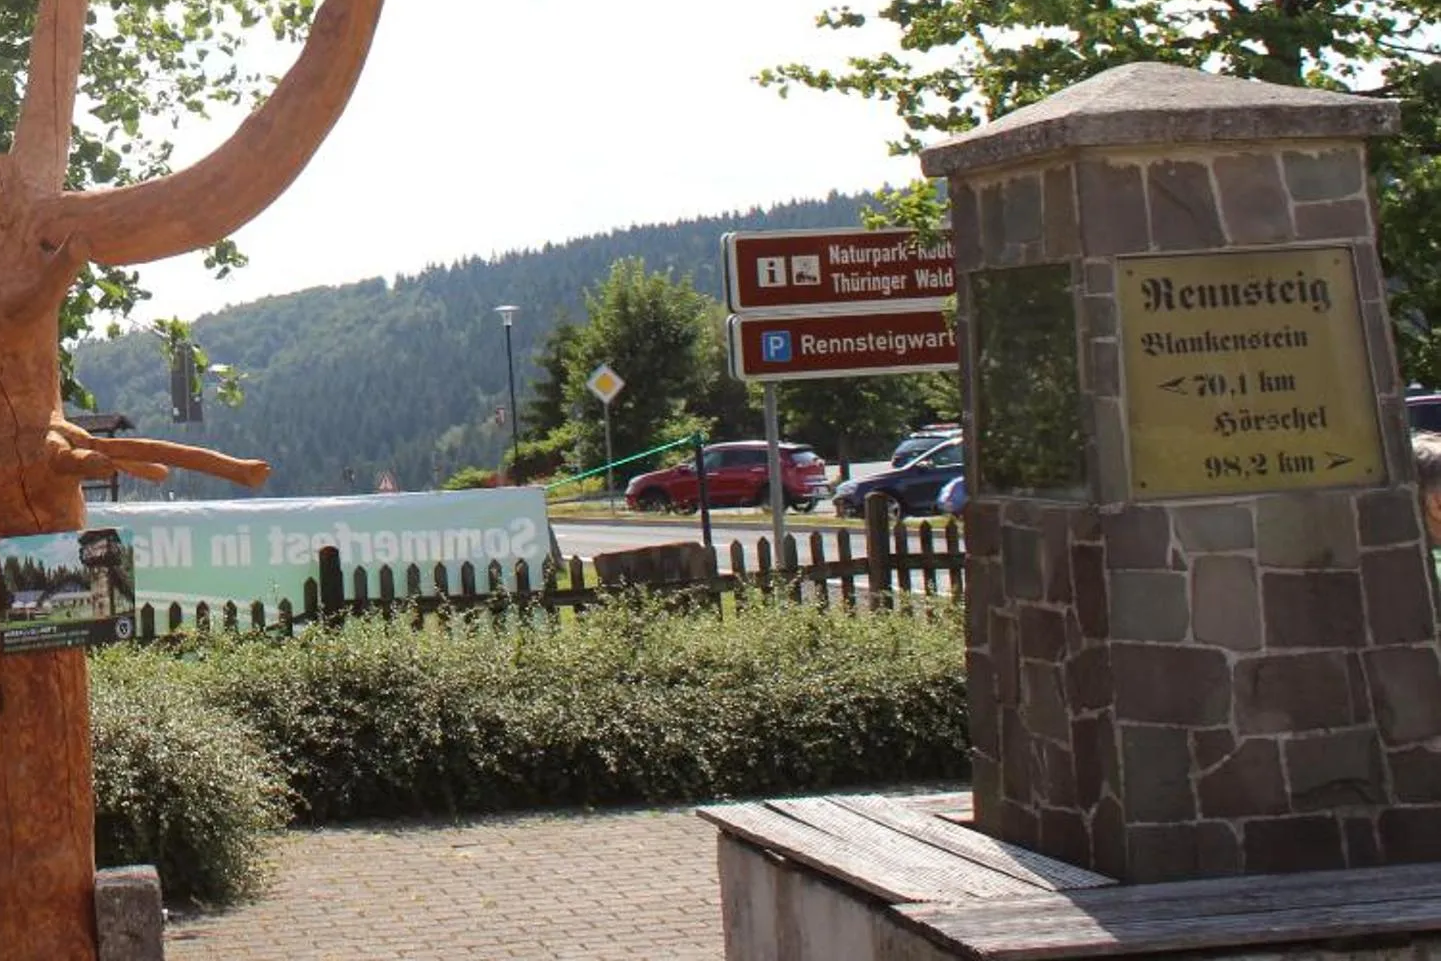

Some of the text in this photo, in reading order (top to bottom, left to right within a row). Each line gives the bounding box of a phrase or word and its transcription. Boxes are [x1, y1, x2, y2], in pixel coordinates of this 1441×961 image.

[831, 266, 954, 295] Thüringer Wald
[1141, 271, 1332, 313] Rennsteig
[769, 336, 785, 359] P
[1141, 325, 1309, 357] Blankenstein
[1193, 370, 1296, 399] 70,1 km
[1213, 406, 1328, 437] Hörschel
[1203, 451, 1315, 479] 98,2 km
